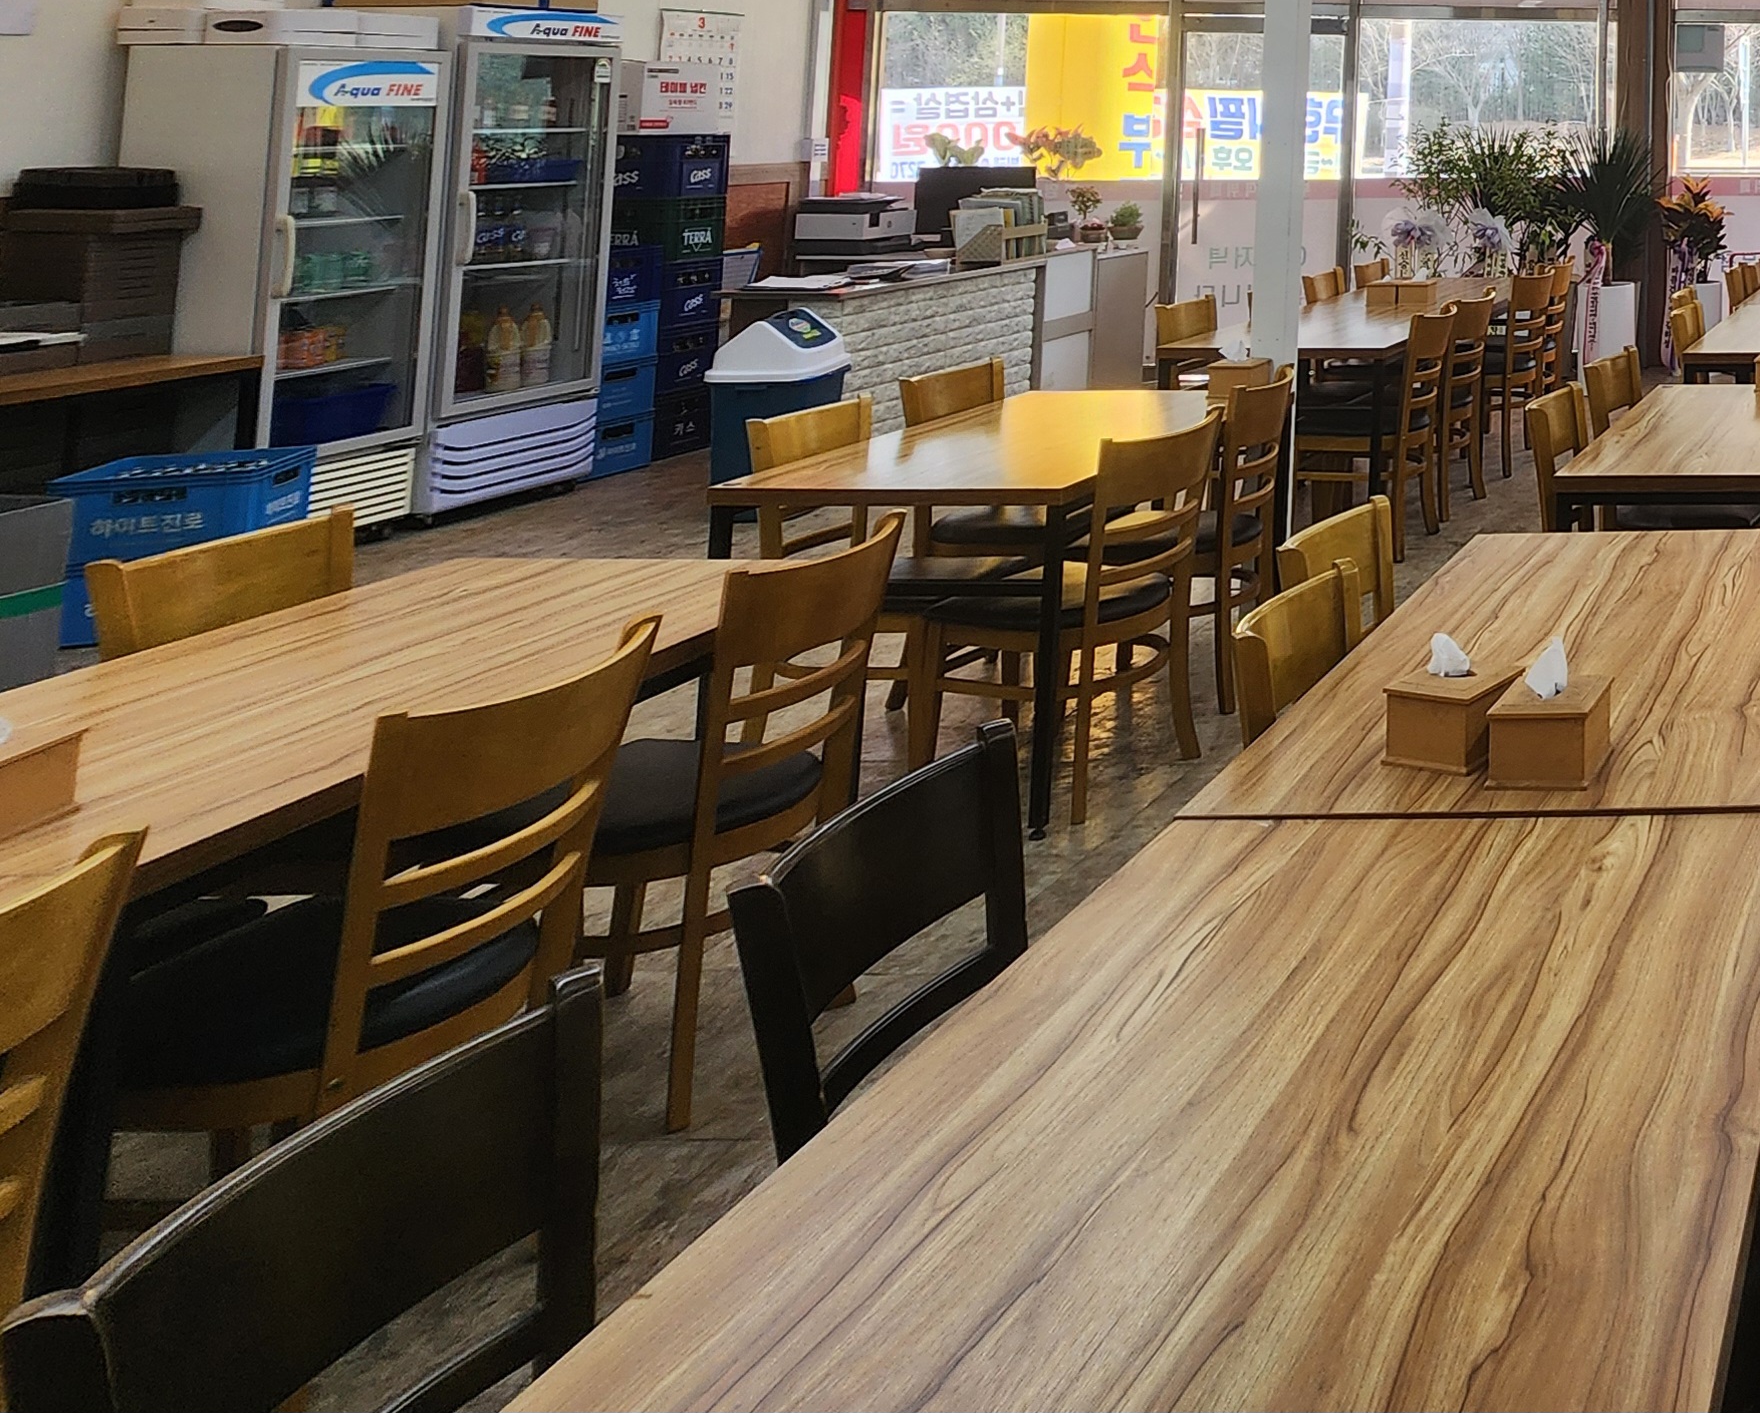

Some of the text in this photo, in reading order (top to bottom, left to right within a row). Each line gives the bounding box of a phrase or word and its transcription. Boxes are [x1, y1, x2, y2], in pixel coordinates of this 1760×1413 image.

[530, 22, 568, 38] Aqua
[571, 25, 601, 38] FINE
[698, 17, 705, 29] 3
[726, 72, 734, 80] 15
[333, 83, 423, 98] Aqua FINE
[660, 81, 707, 95] 테이블 냅킨
[724, 87, 733, 95] 22
[724, 101, 733, 110] 29
[613, 170, 641, 187] ass
[690, 167, 712, 184] Cass
[610, 230, 640, 247] ERRA
[683, 293, 704, 312] Cass
[679, 358, 699, 377] Cass
[90, 511, 205, 538] 하이트진로
